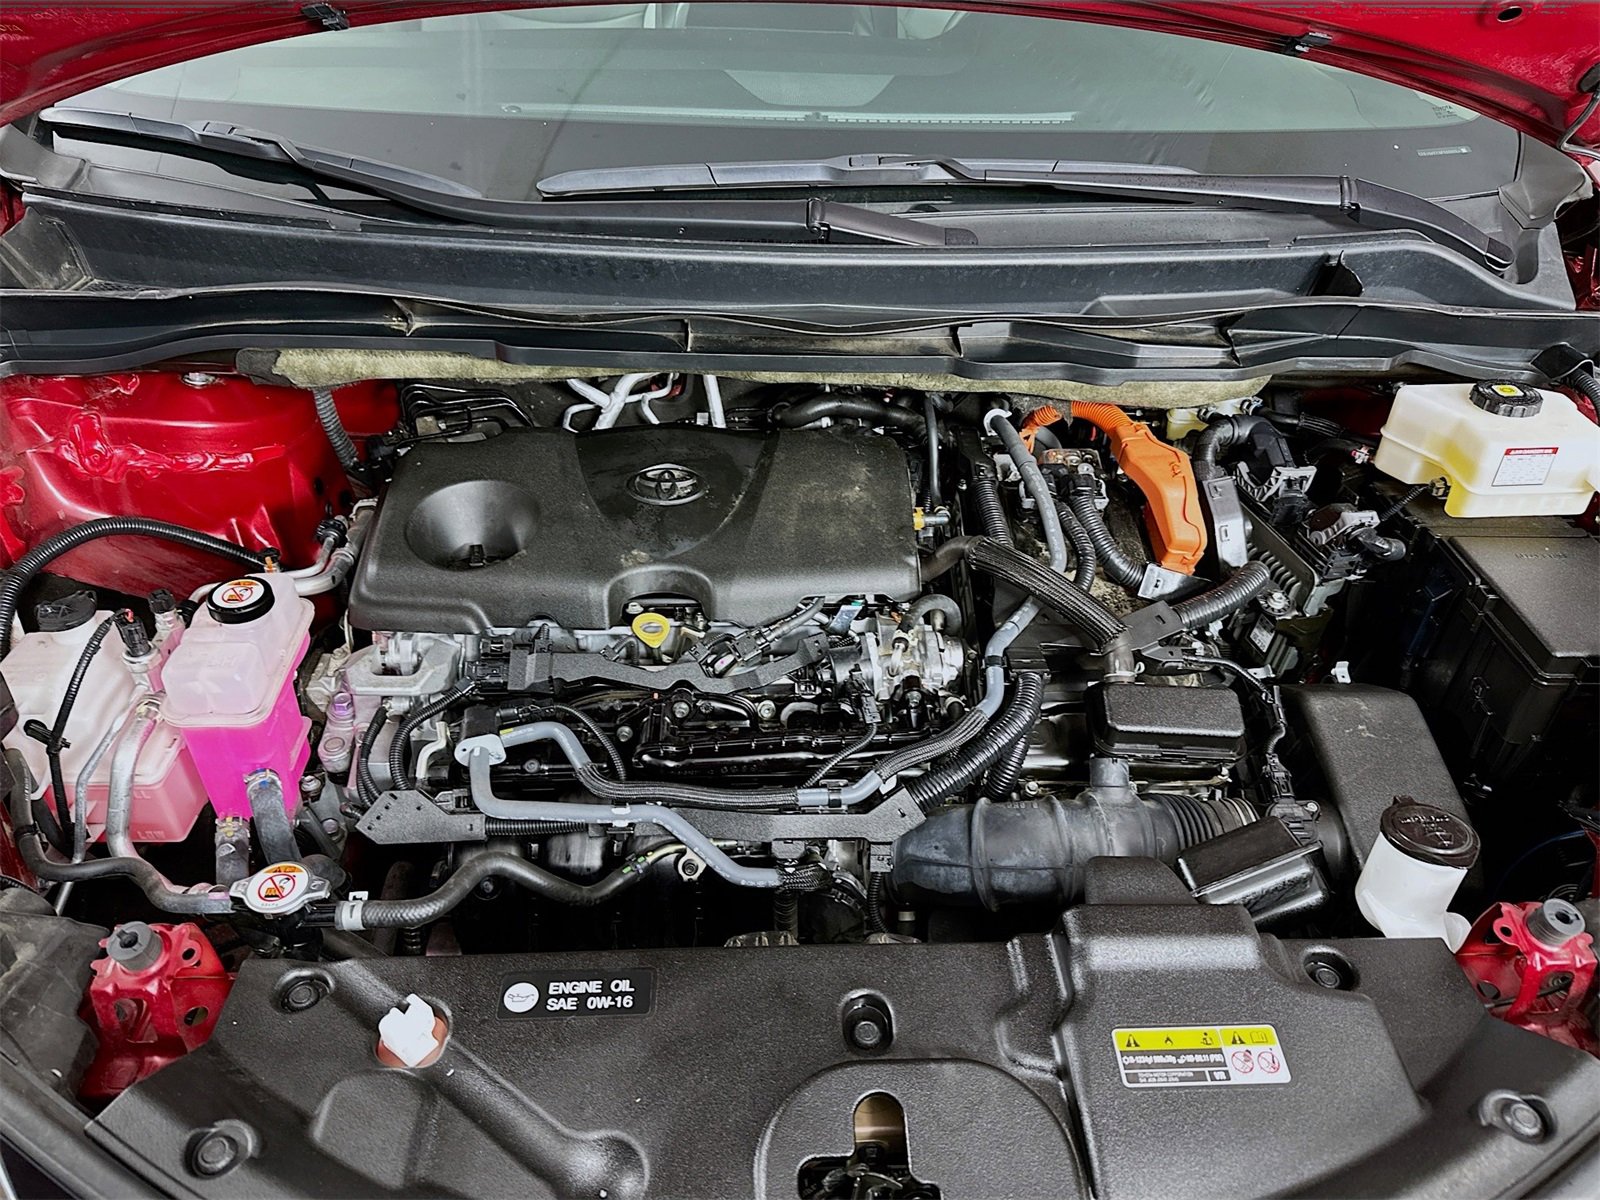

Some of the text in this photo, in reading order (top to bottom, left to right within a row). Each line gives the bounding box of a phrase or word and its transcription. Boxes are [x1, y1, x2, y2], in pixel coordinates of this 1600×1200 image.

[548, 979, 635, 995] ENGINE OIL
[546, 995, 633, 1011] SAE 0W-16
